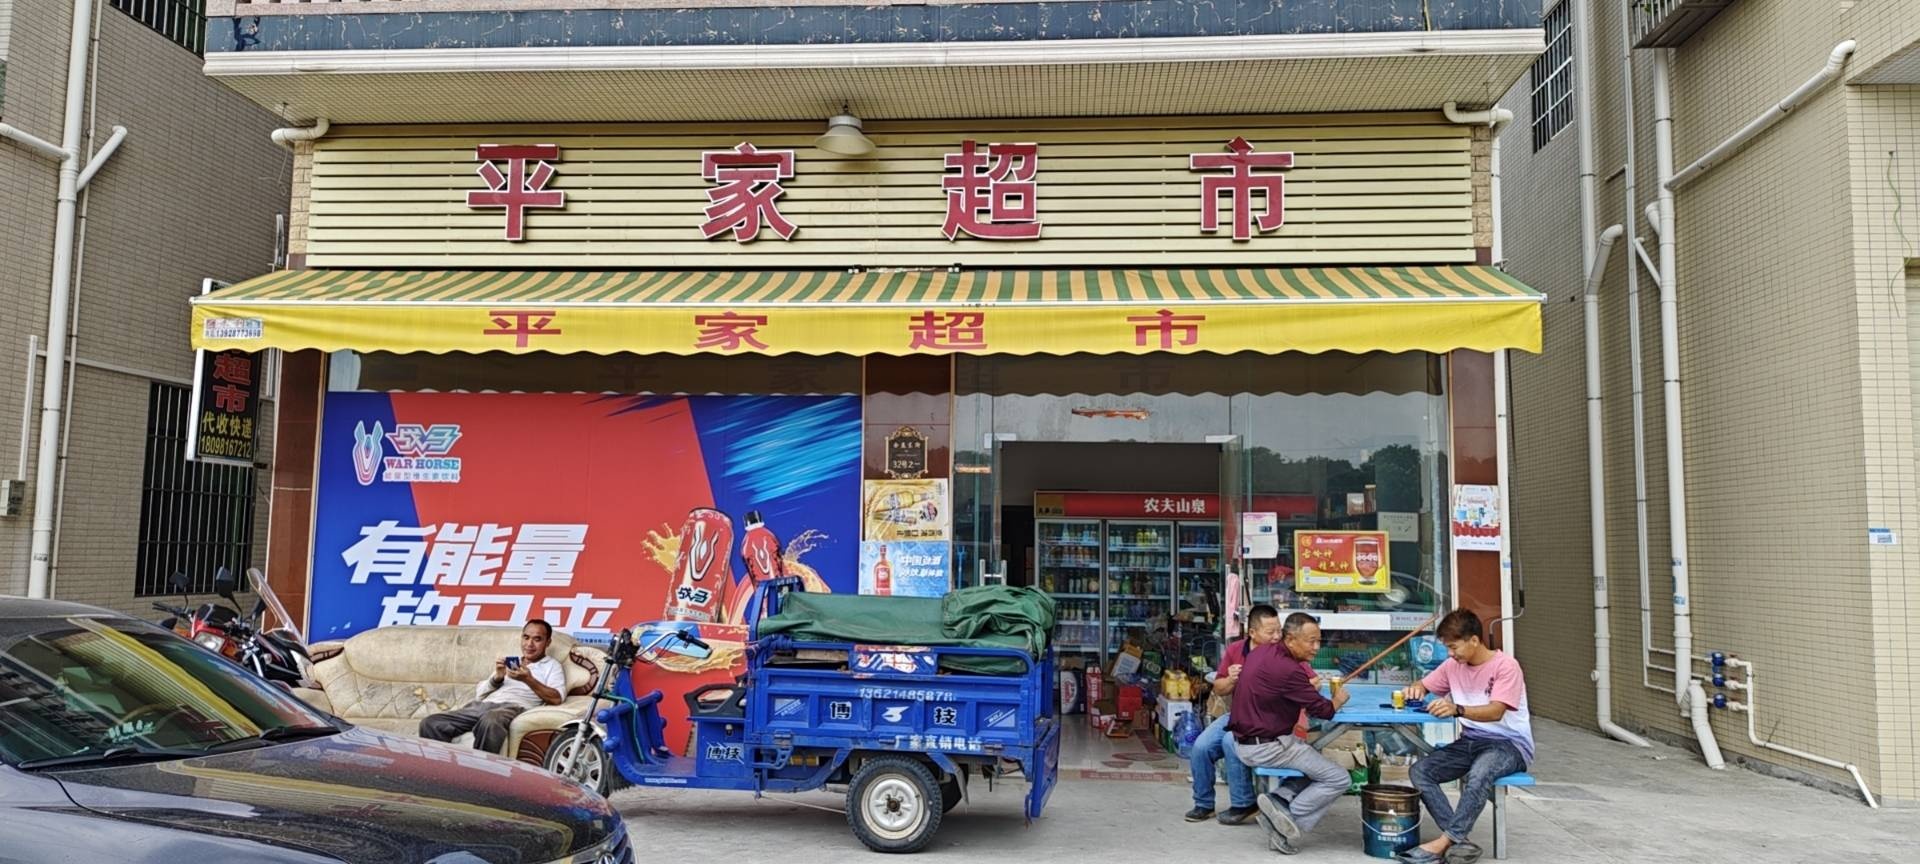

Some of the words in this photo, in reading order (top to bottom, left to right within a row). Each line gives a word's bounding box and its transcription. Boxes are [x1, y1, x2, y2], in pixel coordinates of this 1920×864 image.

[466, 137, 1294, 243] 平家超市
[483, 309, 1206, 350] 平家超市
[213, 353, 252, 413] 超市
[202, 411, 253, 439] 代收快递
[201, 435, 252, 459] 18098167212
[386, 458, 413, 469] WAR
[415, 458, 460, 470] HORSE
[1144, 498, 1206, 514] 农夫山泉
[341, 520, 589, 587] 有能量
[895, 734, 982, 751] 厂家直销电话
